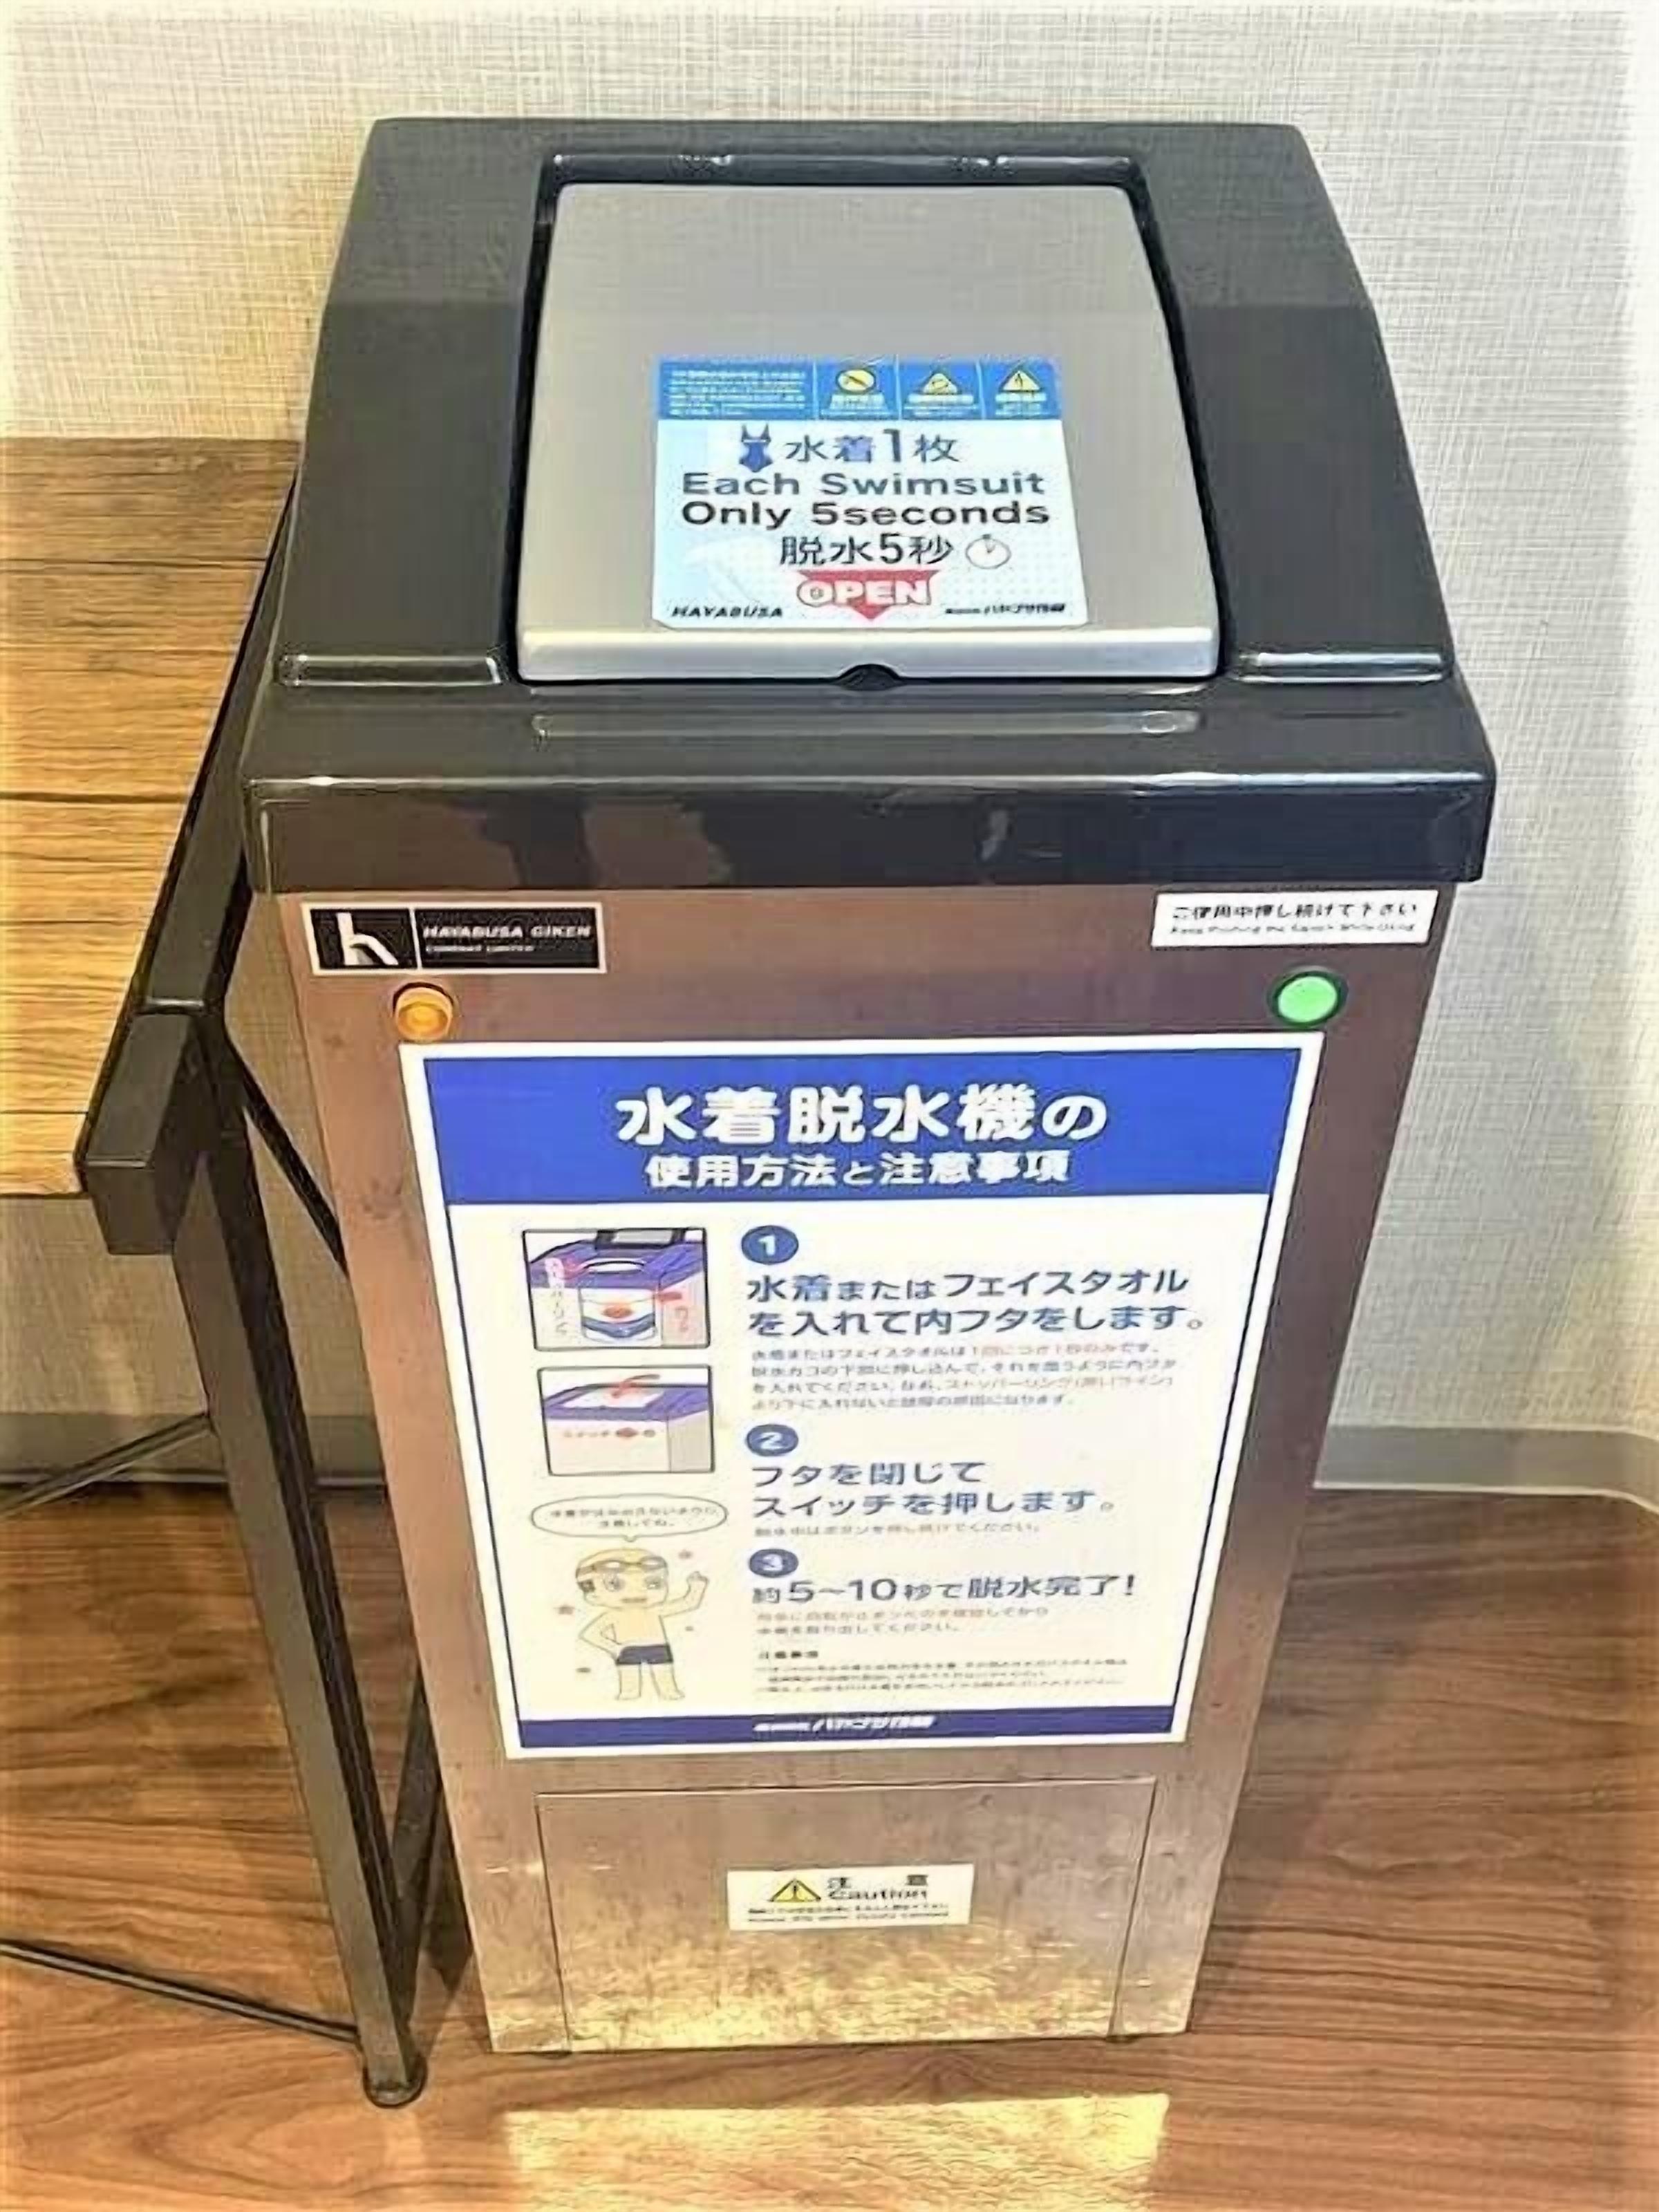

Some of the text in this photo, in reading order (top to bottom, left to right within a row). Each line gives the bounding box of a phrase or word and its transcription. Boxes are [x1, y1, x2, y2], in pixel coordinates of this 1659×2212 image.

[785, 429, 959, 463] 水着1枚
[683, 470, 1044, 495] Each Swimsuit
[682, 500, 1049, 530] Only 5seconds
[780, 532, 953, 565] 脱水5秒
[797, 577, 931, 606] OPEN
[672, 606, 782, 618] HAYABUSA
[615, 1083, 1107, 1145] 水着脱水機の
[645, 1150, 1070, 1188] 使用方法と注意事項
[747, 1269, 1189, 1302] 水着またはフェイスタオル
[749, 1306, 1202, 1337] を入れて内フタをします。
[752, 1462, 985, 1487] フタを閉じて
[753, 1490, 1113, 1517] スイッチを押します。
[827, 1887, 926, 1900] Caution
